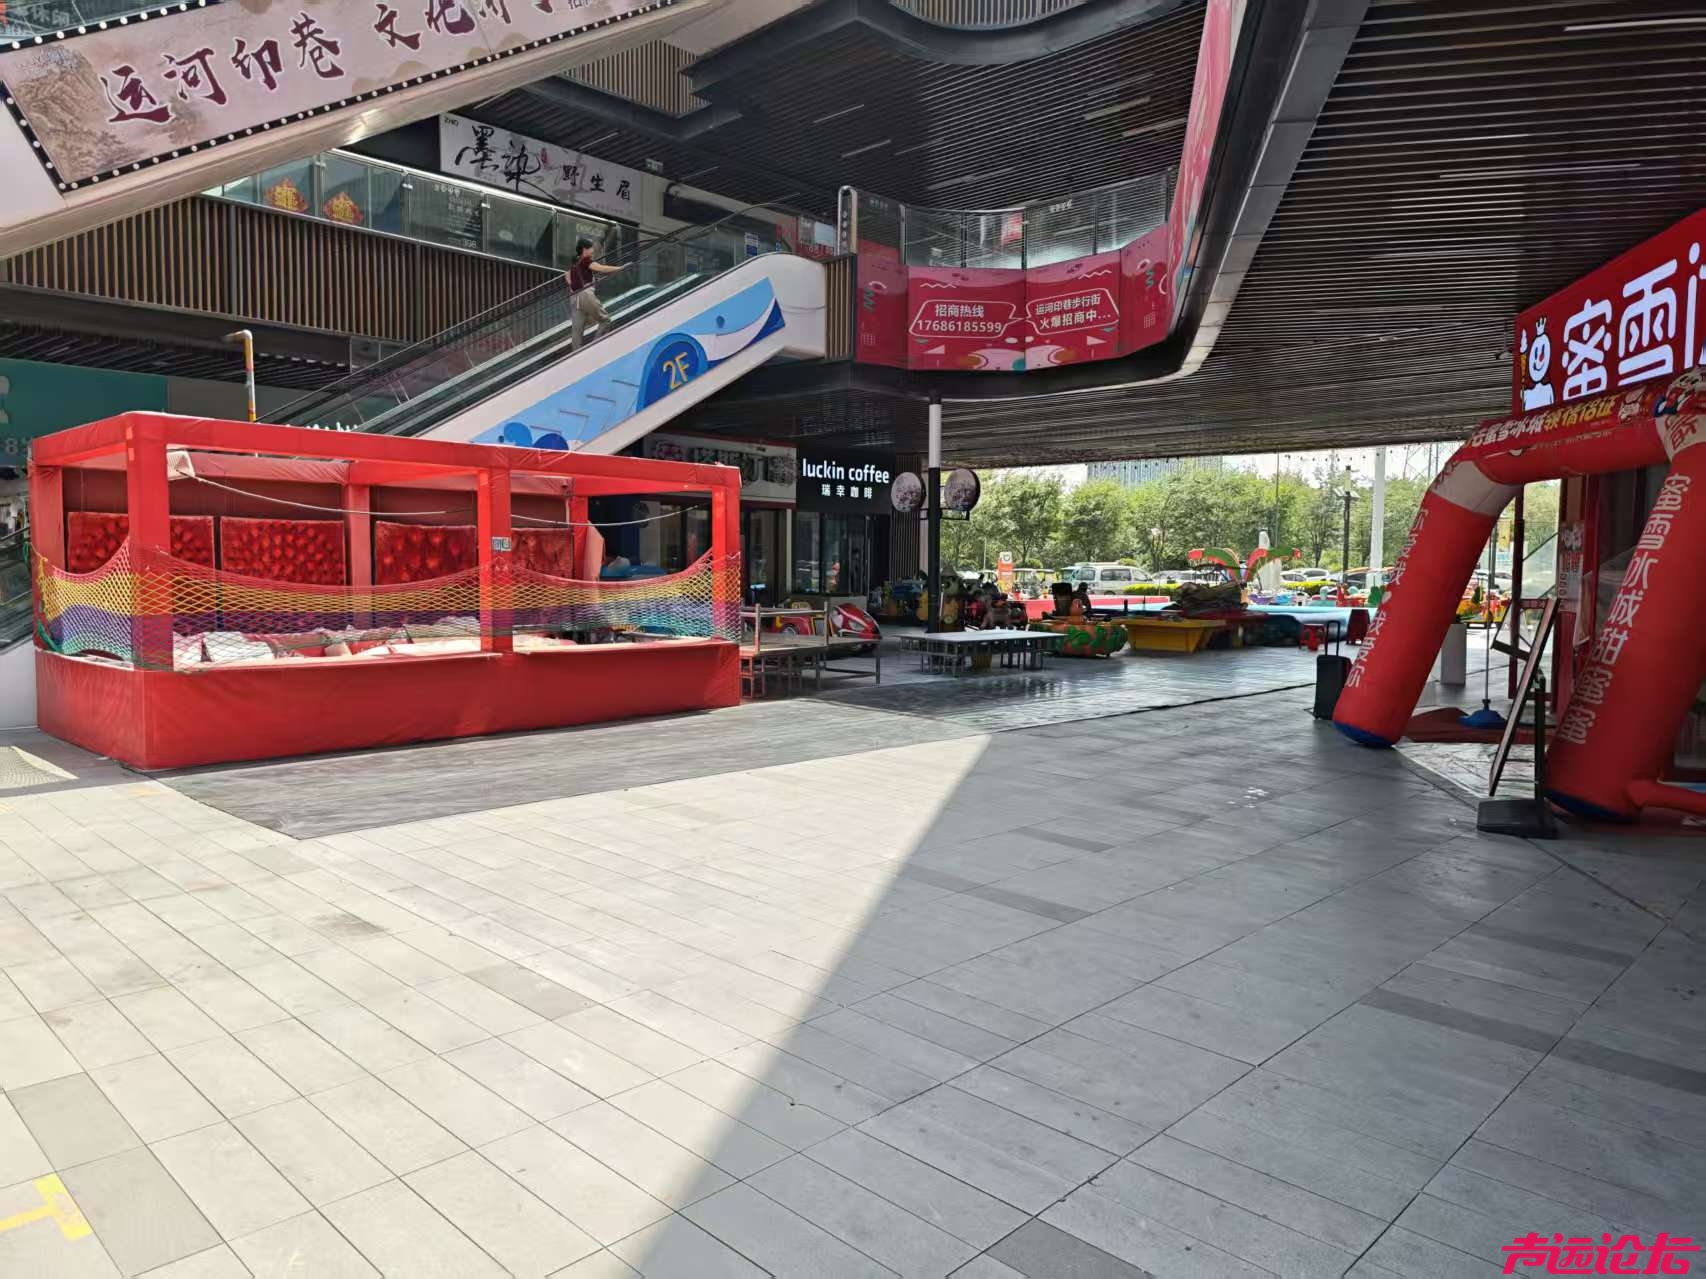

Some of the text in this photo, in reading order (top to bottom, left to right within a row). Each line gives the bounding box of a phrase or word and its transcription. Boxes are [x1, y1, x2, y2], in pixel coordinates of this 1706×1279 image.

[101, 13, 344, 123] 运河印巷
[562, 165, 630, 200] 野生眉
[935, 304, 985, 318] 招商热线
[1036, 294, 1101, 315] 运河印巷步行街
[917, 320, 1001, 333] 17686185599
[663, 352, 690, 389] 2F
[802, 458, 845, 480] luckin
[848, 464, 890, 484] coffee
[821, 484, 873, 499] 瑞幸咖啡
[1560, 473, 1692, 745] 蜜雪冰城甜蜜蜜
